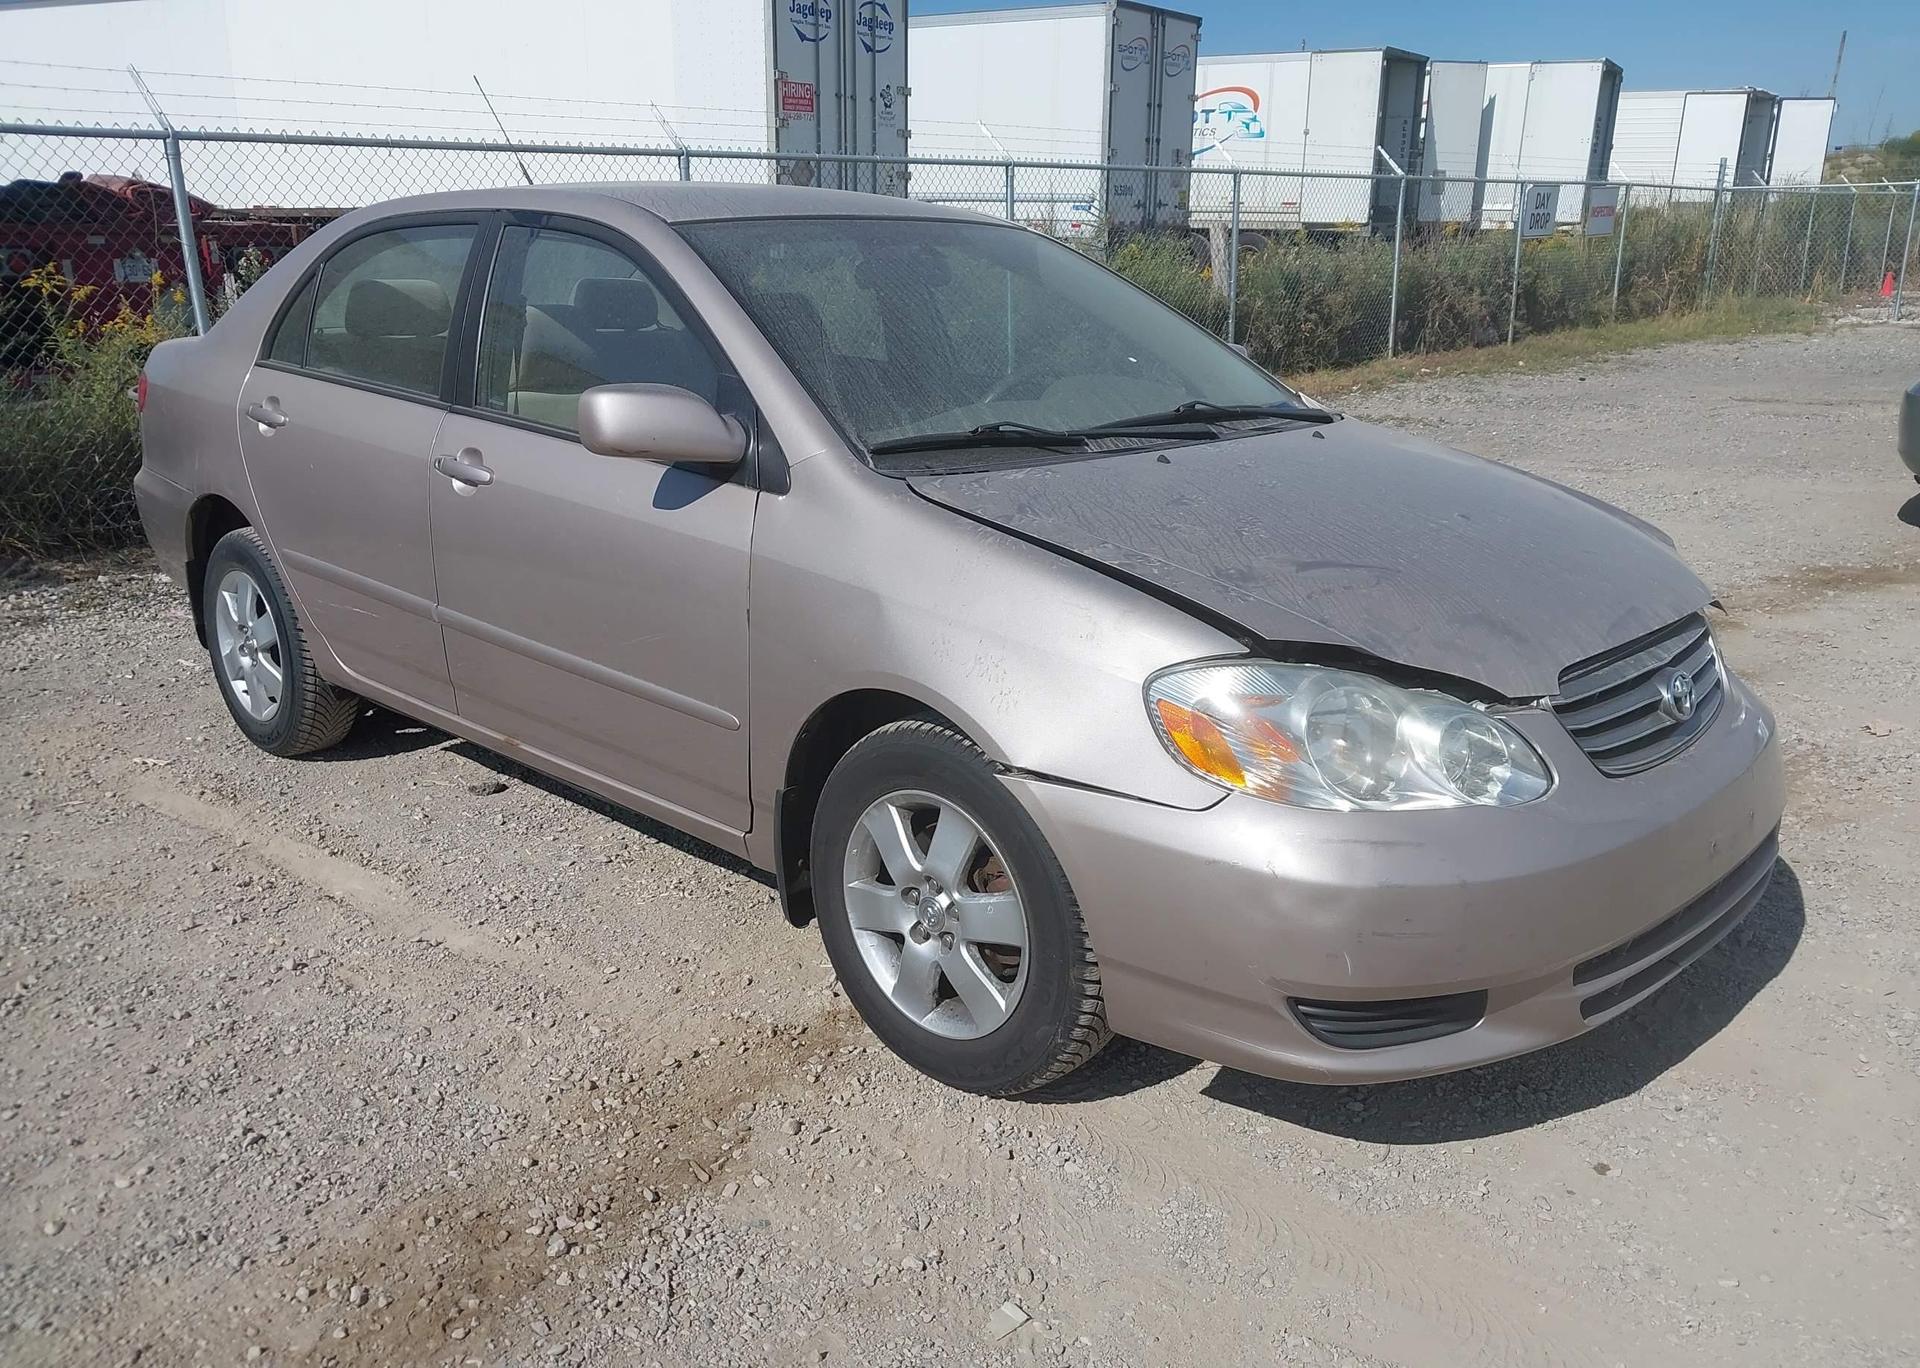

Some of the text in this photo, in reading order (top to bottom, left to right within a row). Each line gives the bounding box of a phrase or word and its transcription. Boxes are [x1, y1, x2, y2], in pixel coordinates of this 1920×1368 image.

[789, 0, 832, 23] Jagdep
[782, 83, 813, 99] HIRING!
[1535, 192, 1551, 210] DAY
[1529, 212, 1551, 230] DROP
